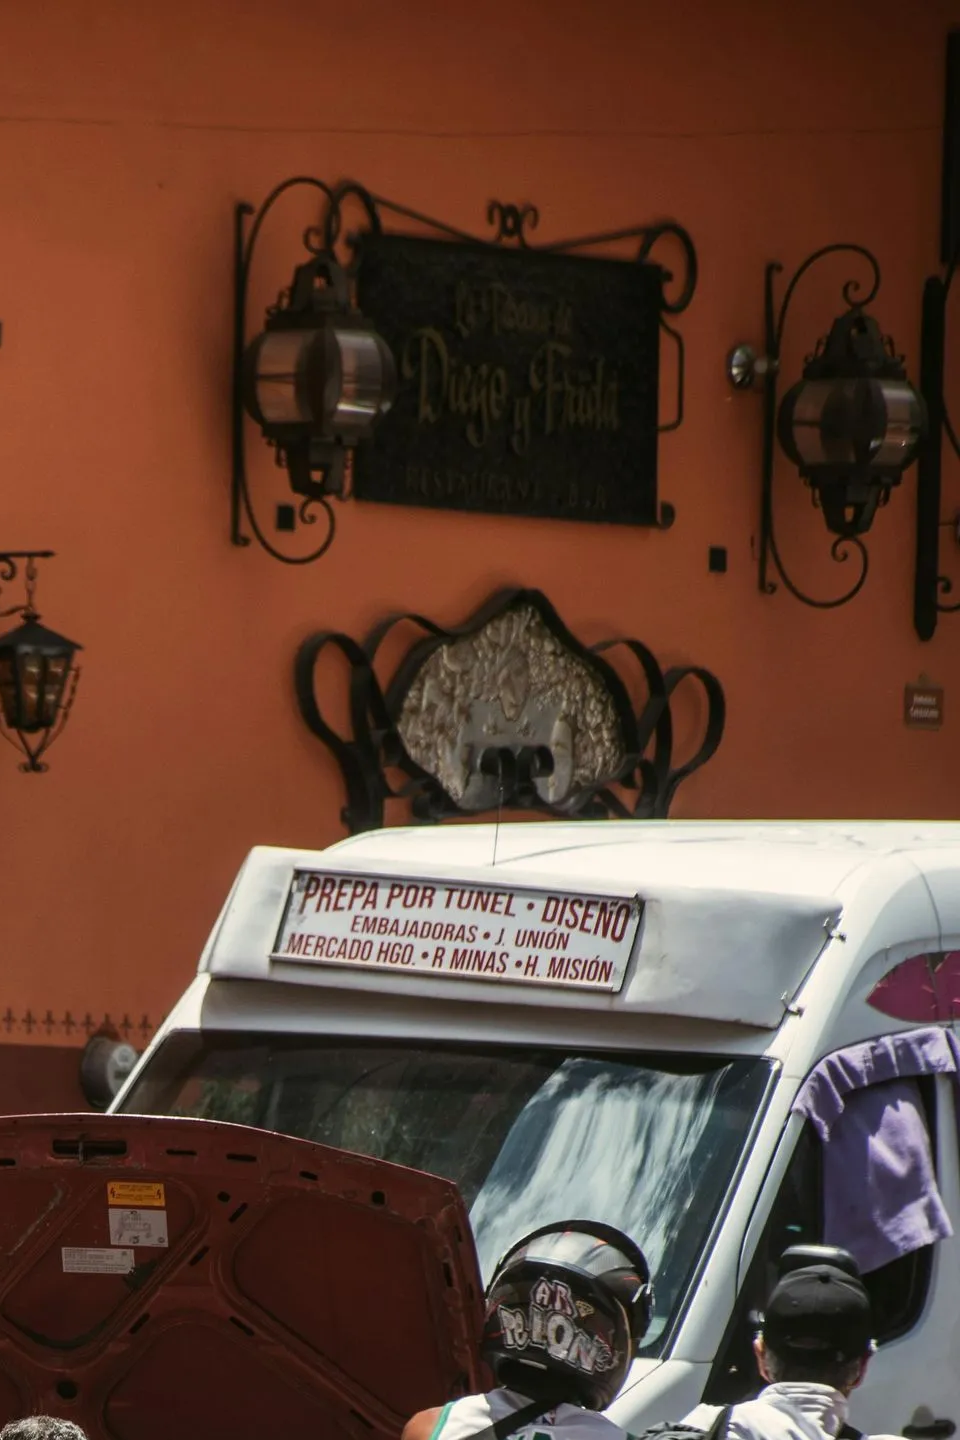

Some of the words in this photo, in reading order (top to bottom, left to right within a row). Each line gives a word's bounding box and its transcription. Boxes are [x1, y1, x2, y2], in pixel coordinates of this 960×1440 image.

[402, 326, 508, 448] Diego
[512, 396, 531, 456] y
[530, 342, 620, 435] Frida
[299, 874, 380, 914] PREPA
[385, 883, 437, 910] POR
[444, 887, 516, 917] TUNEL
[541, 896, 631, 943] DISEÑO
[351, 915, 479, 944] EMBAJADORAS
[495, 928, 505, 947] J.
[515, 927, 570, 951] UNIÓN
[286, 933, 374, 961] MERCADO
[376, 941, 416, 966] HGO.
[432, 946, 446, 968] R
[449, 948, 510, 974] MINAS
[524, 955, 540, 977] H.
[547, 955, 614, 983] MISIÓN
[530, 1276, 578, 1320] AR
